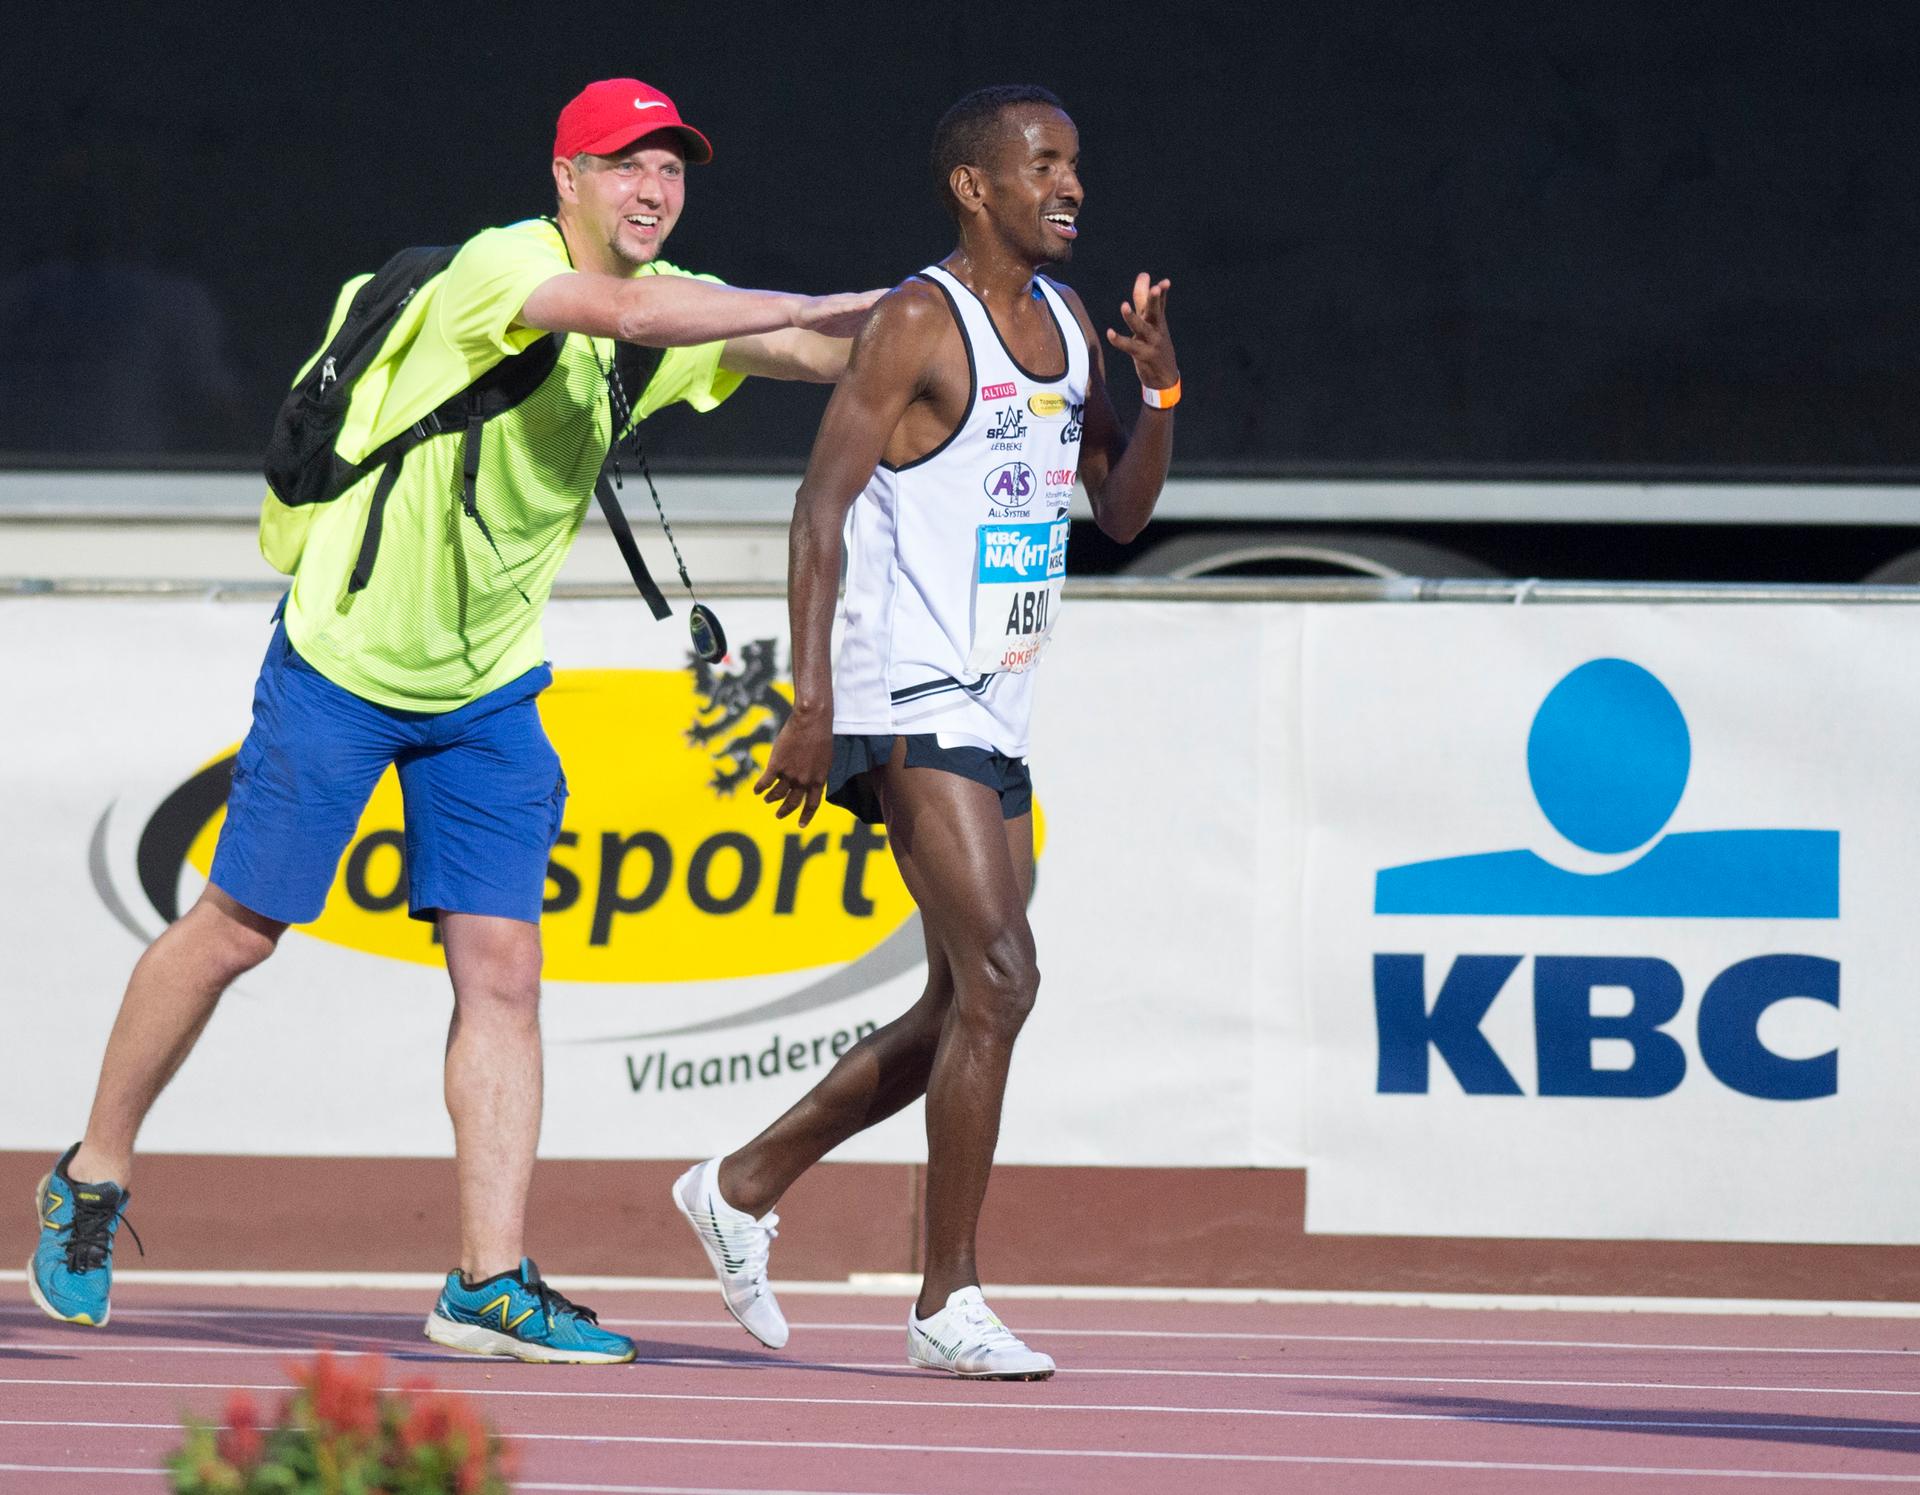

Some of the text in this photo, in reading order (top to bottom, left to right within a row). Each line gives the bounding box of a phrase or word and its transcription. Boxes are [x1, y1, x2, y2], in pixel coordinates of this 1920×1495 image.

[983, 384, 1016, 399] ALTIUS
[996, 405, 1023, 427] TAF
[986, 531, 1020, 546] KBC
[985, 536, 1048, 576] NACHT
[1049, 553, 1063, 570] KBC
[1005, 588, 1049, 636] ABDI
[1372, 953, 1841, 1101] KBC
